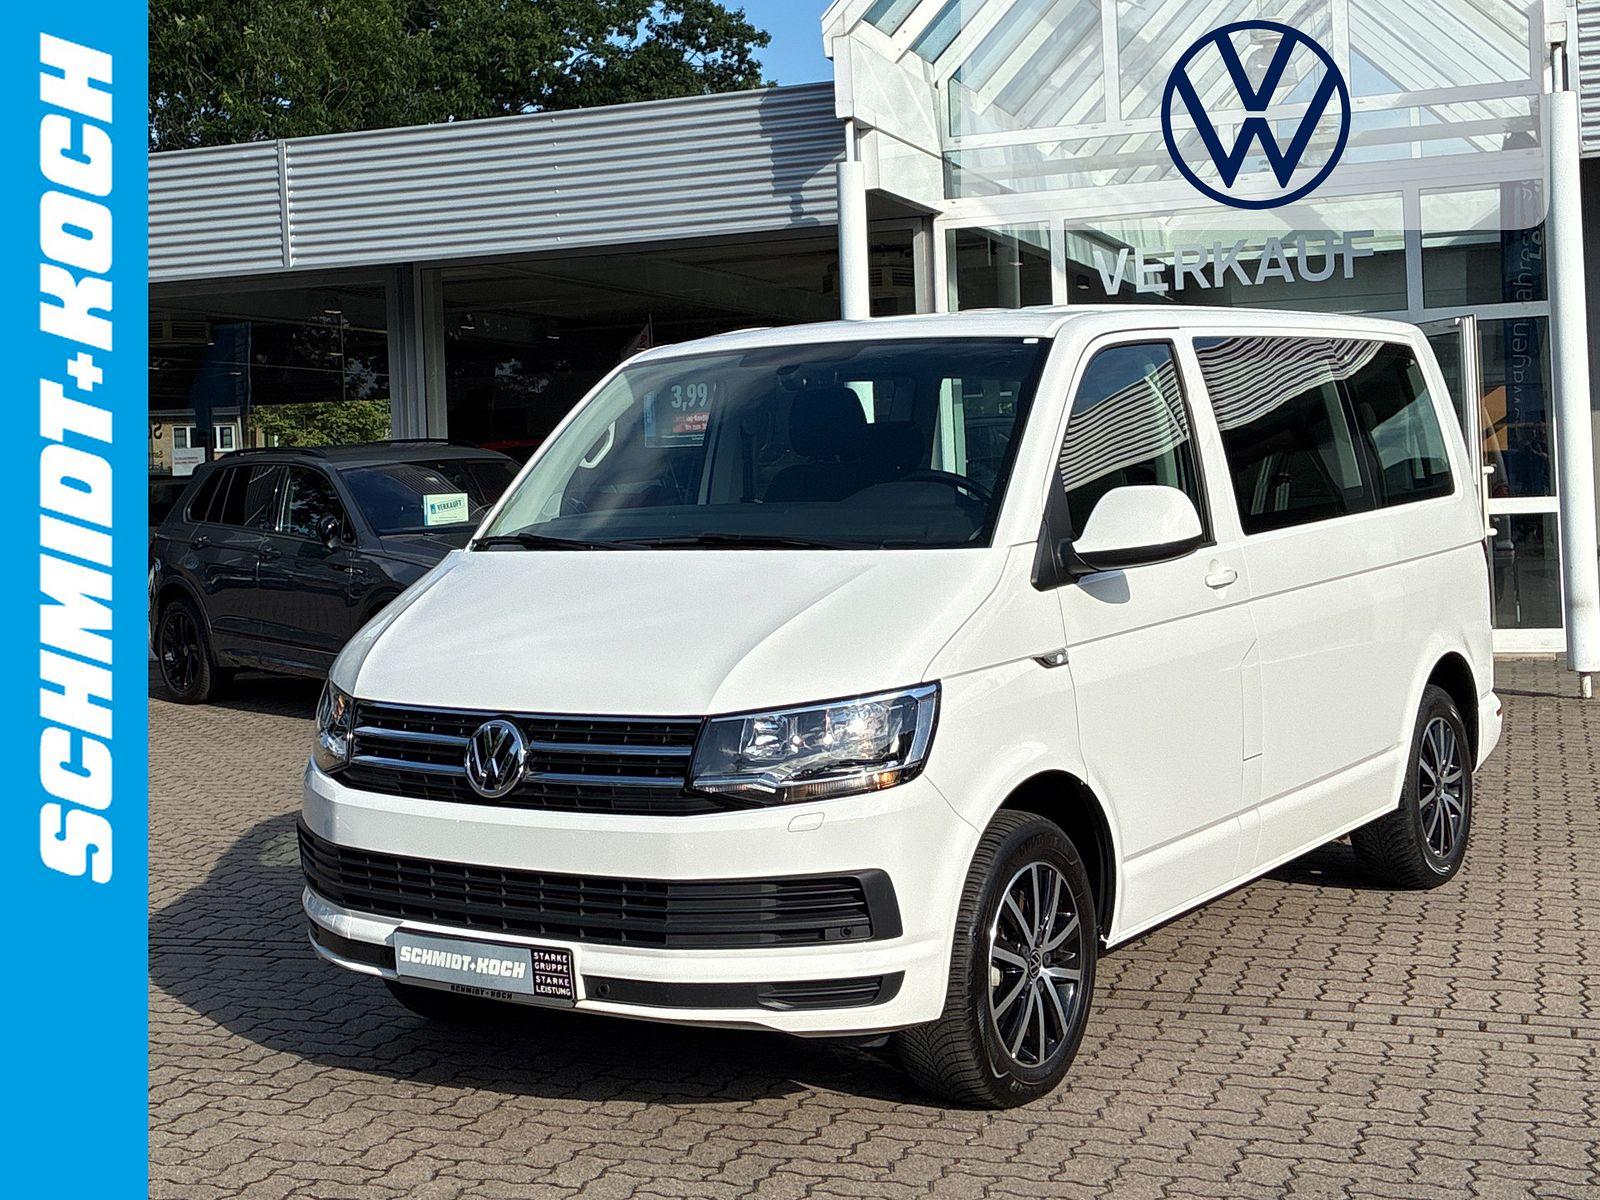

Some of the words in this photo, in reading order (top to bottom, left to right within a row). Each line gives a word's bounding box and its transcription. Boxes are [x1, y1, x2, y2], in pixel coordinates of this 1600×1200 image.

[1094, 229, 1375, 296] VERKAUF
[671, 382, 708, 411] 3,99
[436, 499, 463, 511] VERKAUFT
[399, 945, 527, 979] SCHMIDT+KOCH
[533, 951, 568, 963] STARKE
[534, 961, 568, 973] GRUPPE
[535, 974, 570, 987] STARKE
[535, 985, 572, 997] LEISTUNG
